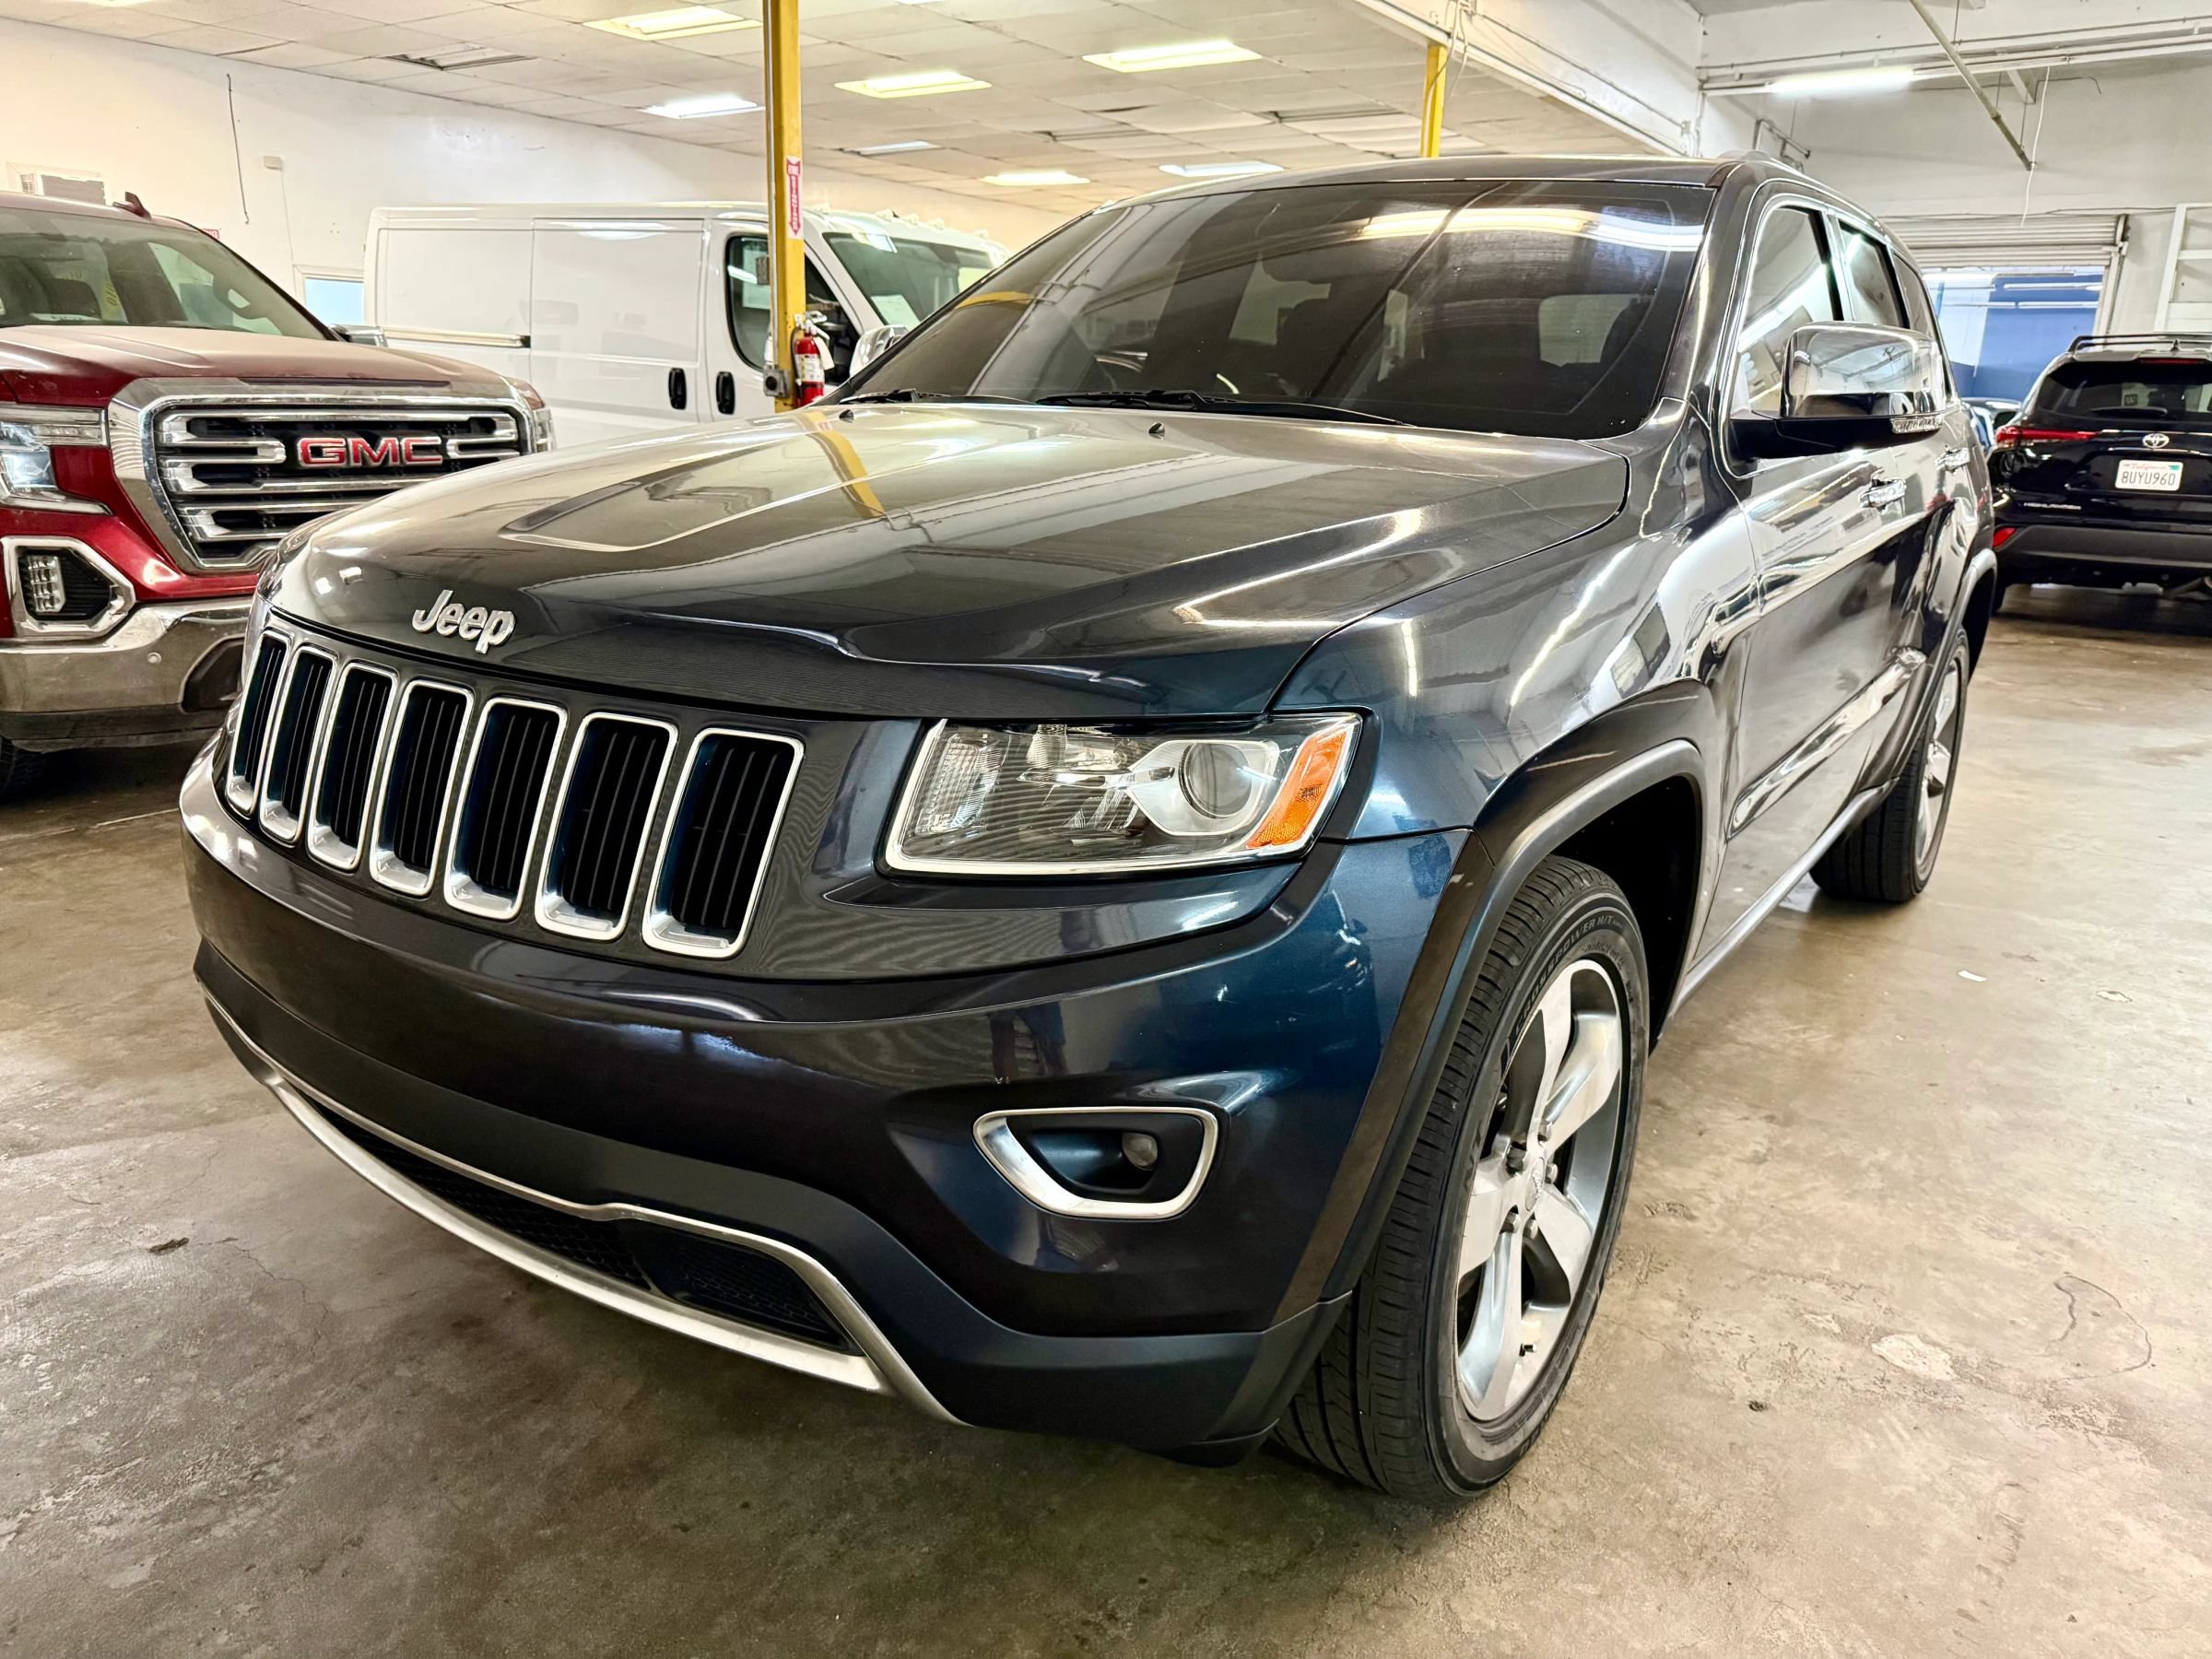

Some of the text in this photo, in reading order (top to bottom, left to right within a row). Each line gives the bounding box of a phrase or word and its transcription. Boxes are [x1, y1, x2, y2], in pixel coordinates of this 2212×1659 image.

[298, 437, 443, 467] GMC
[2121, 471, 2176, 486] 8UYU960
[412, 589, 516, 654] Jeep
